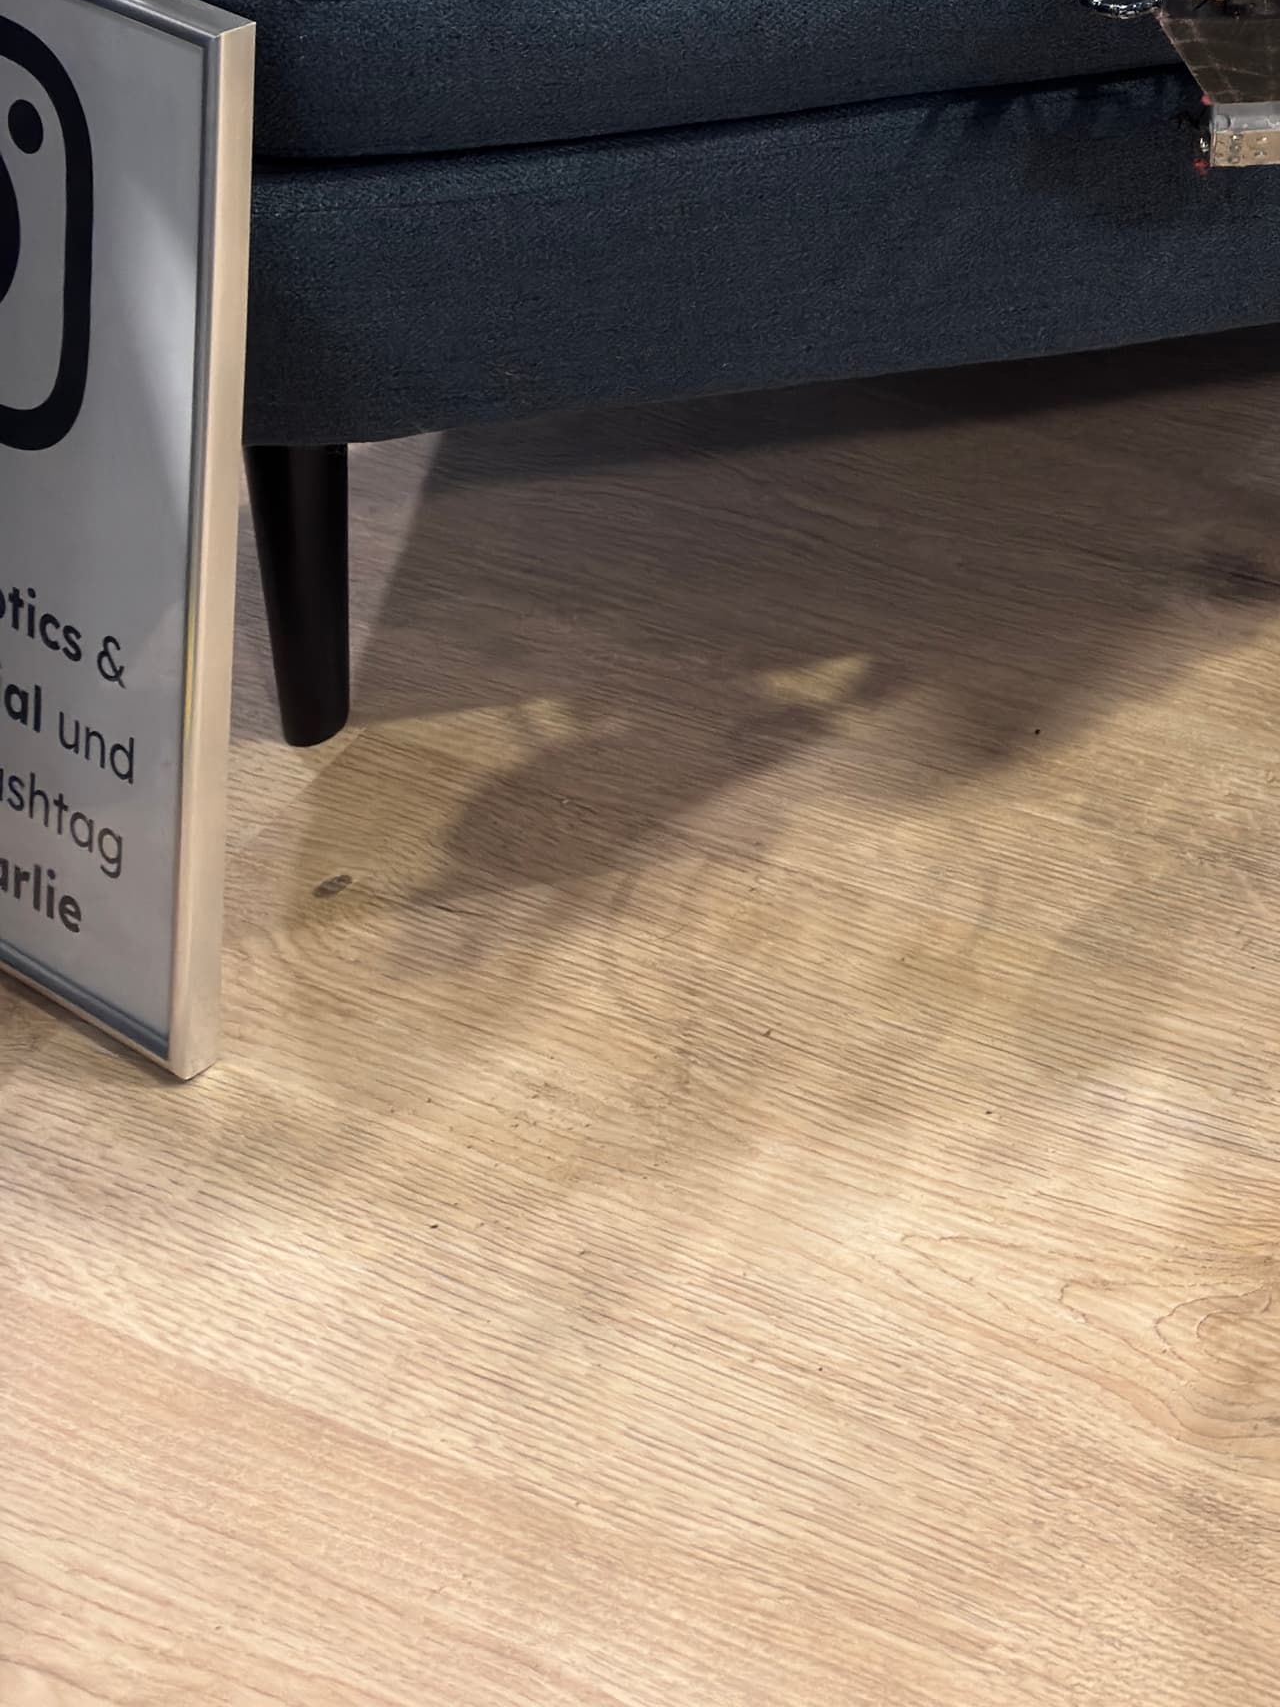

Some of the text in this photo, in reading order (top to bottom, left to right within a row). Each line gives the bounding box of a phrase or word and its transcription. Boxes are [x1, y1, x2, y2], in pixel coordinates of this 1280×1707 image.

[0, 587, 126, 688] tics &
[59, 711, 134, 784] und
[0, 768, 122, 879] shtag
